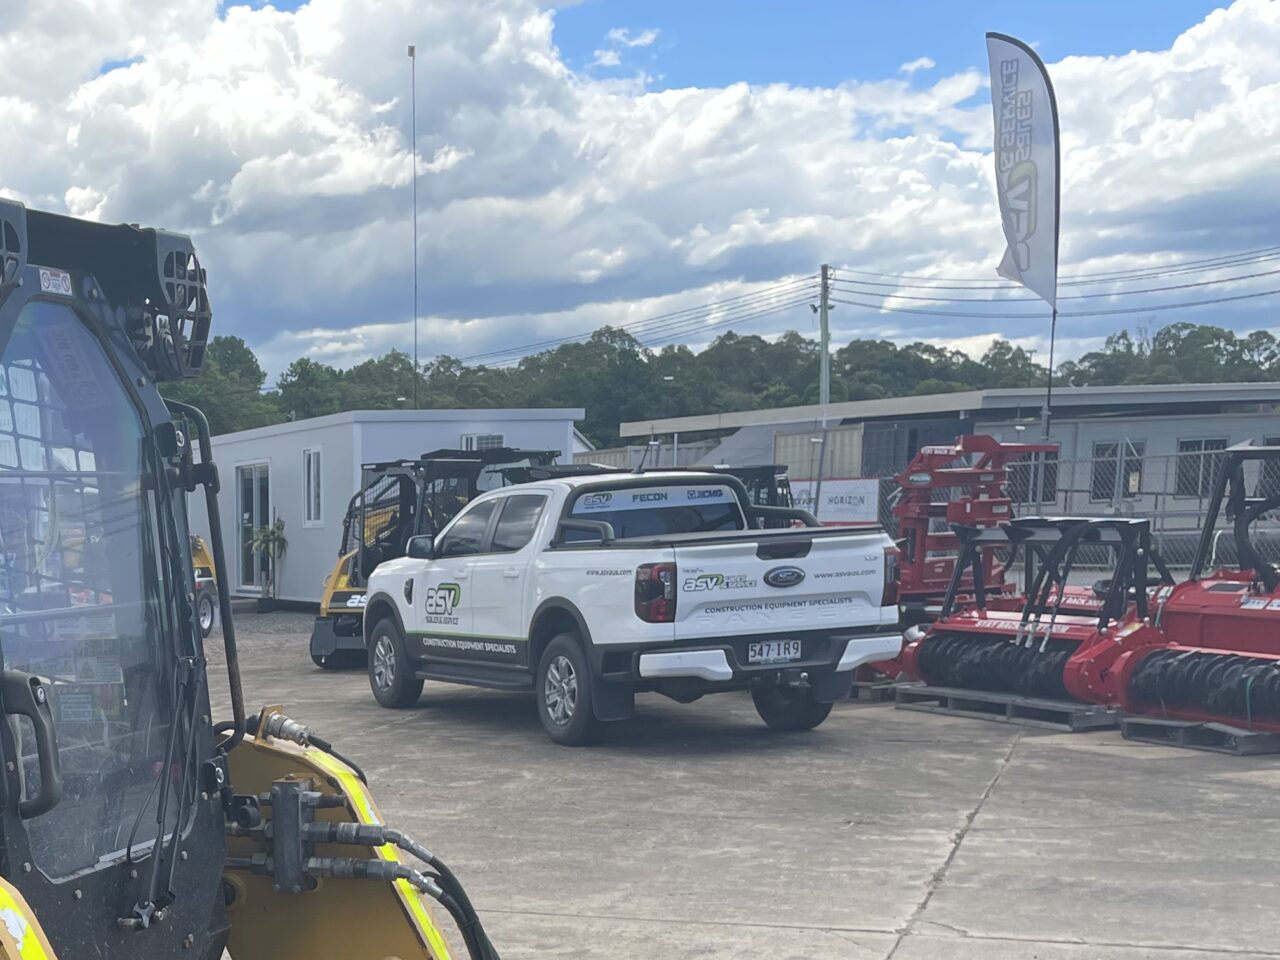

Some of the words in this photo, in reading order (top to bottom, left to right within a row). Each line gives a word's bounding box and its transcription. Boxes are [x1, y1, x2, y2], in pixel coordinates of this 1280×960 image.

[632, 492, 668, 503] FECON
[828, 496, 865, 505] HORIZON
[814, 569, 876, 580] www.asvaus.com
[683, 575, 721, 592] asv
[426, 586, 458, 615] asv
[705, 601, 763, 614] CONSTRUCTION
[765, 599, 807, 611] EQUIPMENT
[809, 597, 853, 607] SPECIALISTS
[422, 637, 457, 648] CONSTRUCTION
[457, 640, 485, 651] EQUIPMENT
[485, 643, 517, 654] SPECIALISTS
